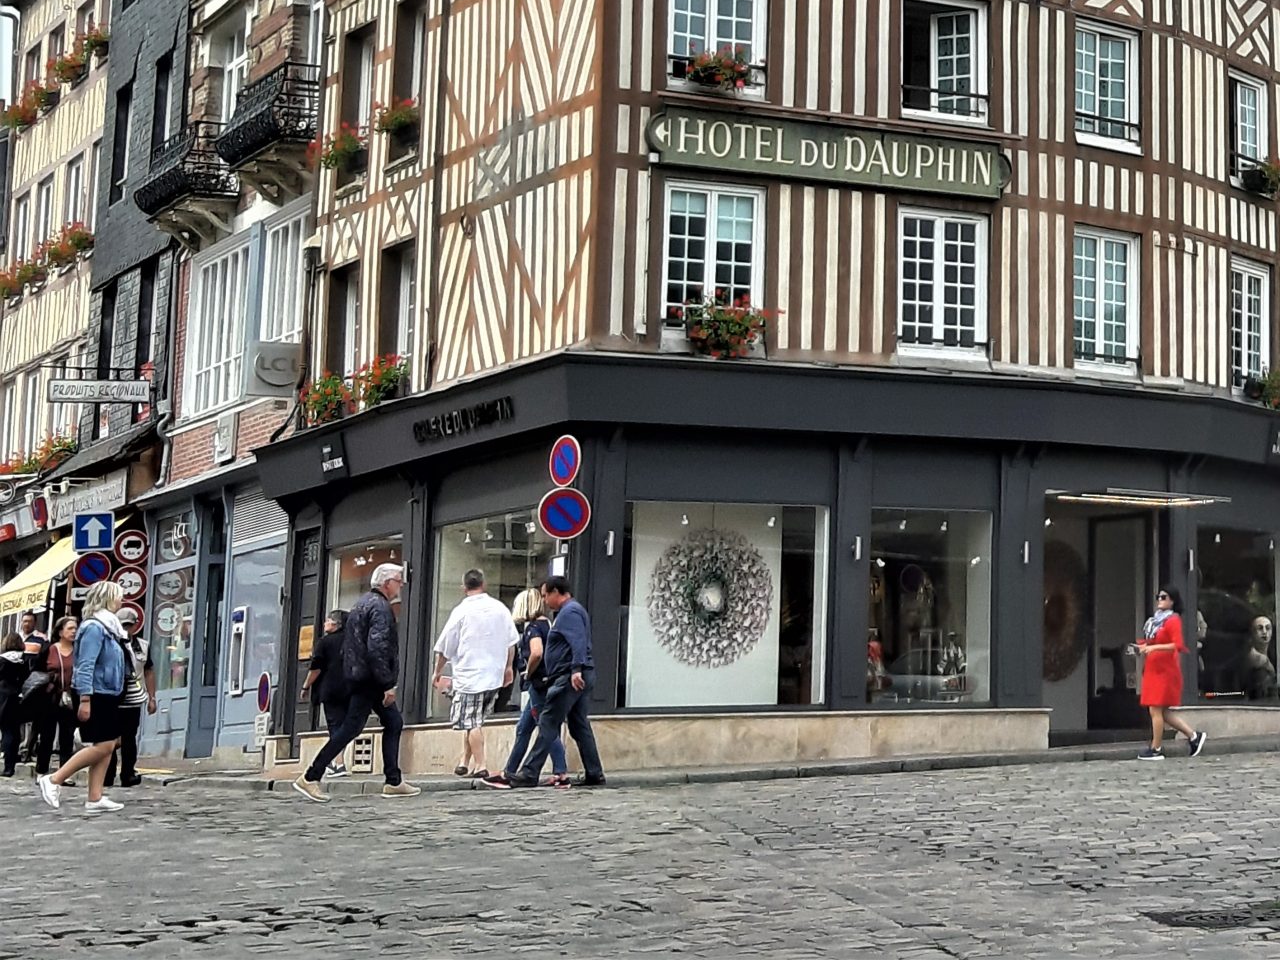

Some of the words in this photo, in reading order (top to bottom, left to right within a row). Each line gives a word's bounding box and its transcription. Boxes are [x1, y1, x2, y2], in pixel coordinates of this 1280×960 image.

[677, 117, 795, 165] HOTEL
[800, 139, 838, 169] DU
[844, 136, 992, 186] DAUPHIN
[52, 384, 95, 397] PRODUITS
